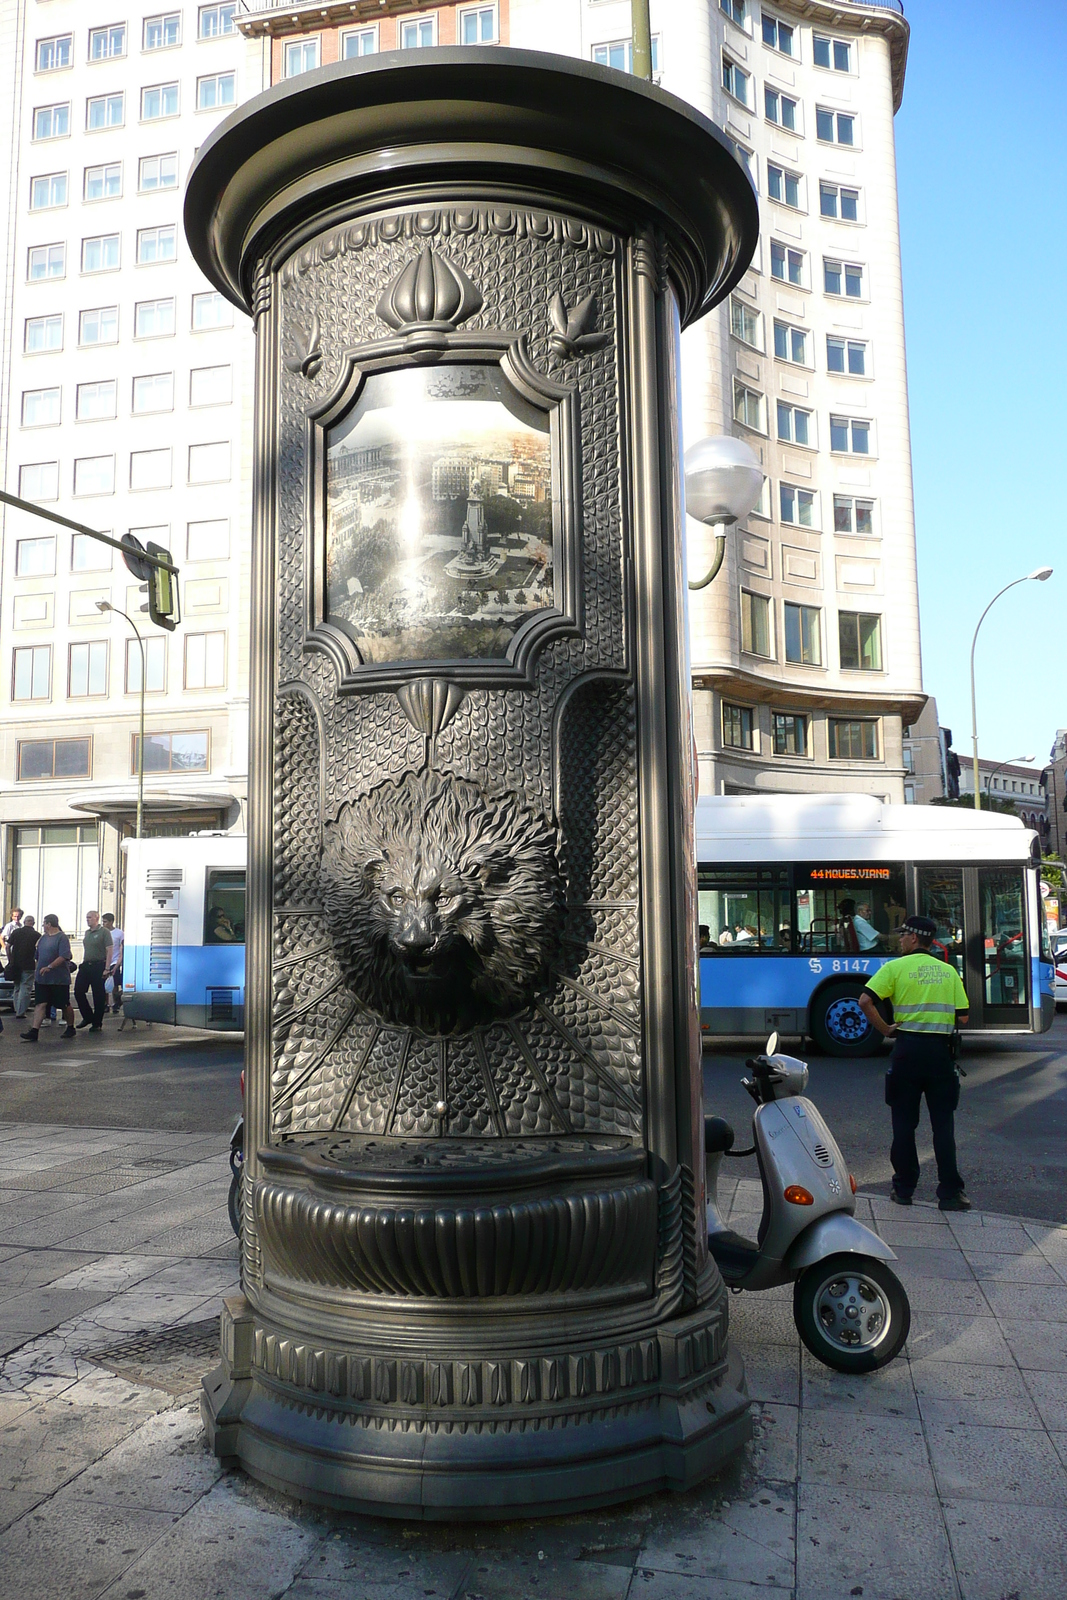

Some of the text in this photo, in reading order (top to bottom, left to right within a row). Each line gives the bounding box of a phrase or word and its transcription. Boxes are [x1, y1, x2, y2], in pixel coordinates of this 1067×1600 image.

[810, 869, 824, 879] 44
[832, 959, 870, 972] 8147
[918, 971, 951, 979] MOVILIDAD
